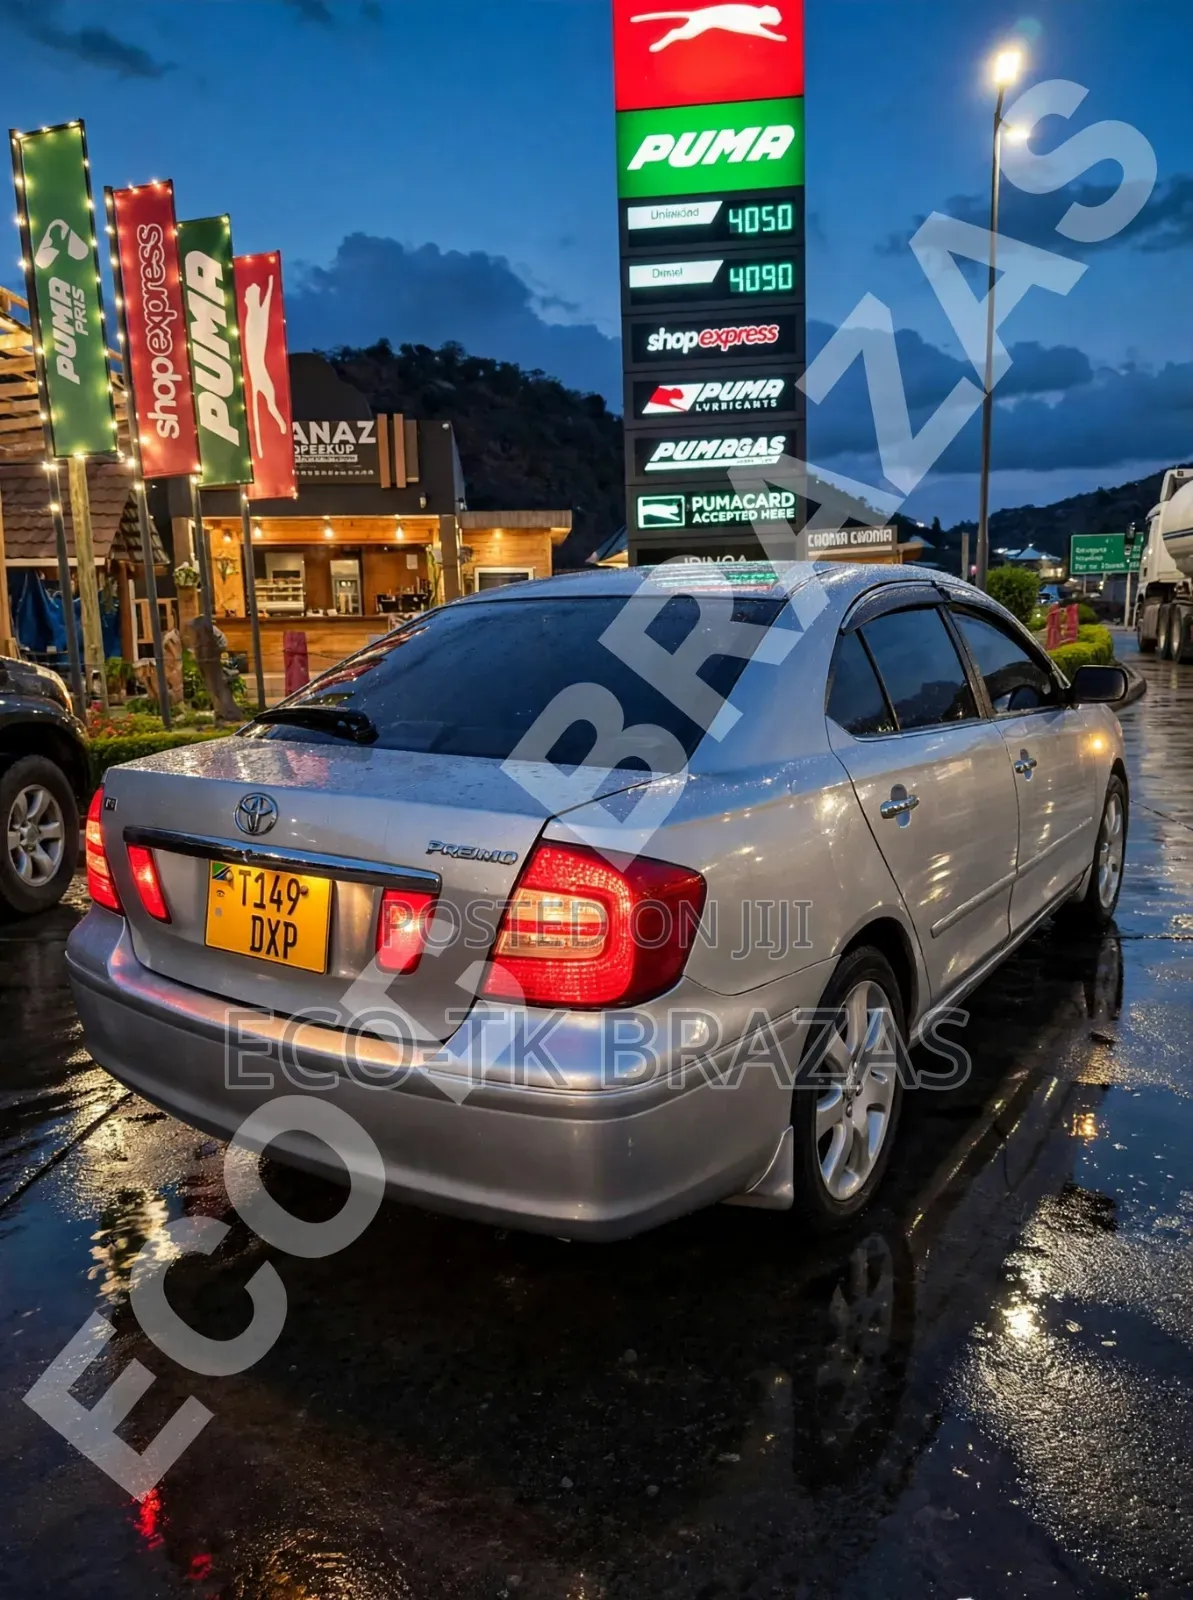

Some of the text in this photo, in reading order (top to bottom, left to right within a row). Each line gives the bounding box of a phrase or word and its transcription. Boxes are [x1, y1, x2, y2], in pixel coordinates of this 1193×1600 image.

[627, 124, 795, 170] PUMA
[729, 204, 792, 233] 4050
[730, 263, 792, 292] 4090
[48, 276, 80, 384] PUMA
[71, 285, 89, 336] PRIS
[184, 250, 239, 446] PUMA
[696, 379, 785, 402] PUMA
[692, 492, 795, 512] PUMACARD
[692, 510, 758, 523] ACCEPTED
[238, 869, 300, 916] T149
[250, 915, 298, 959] DXP
